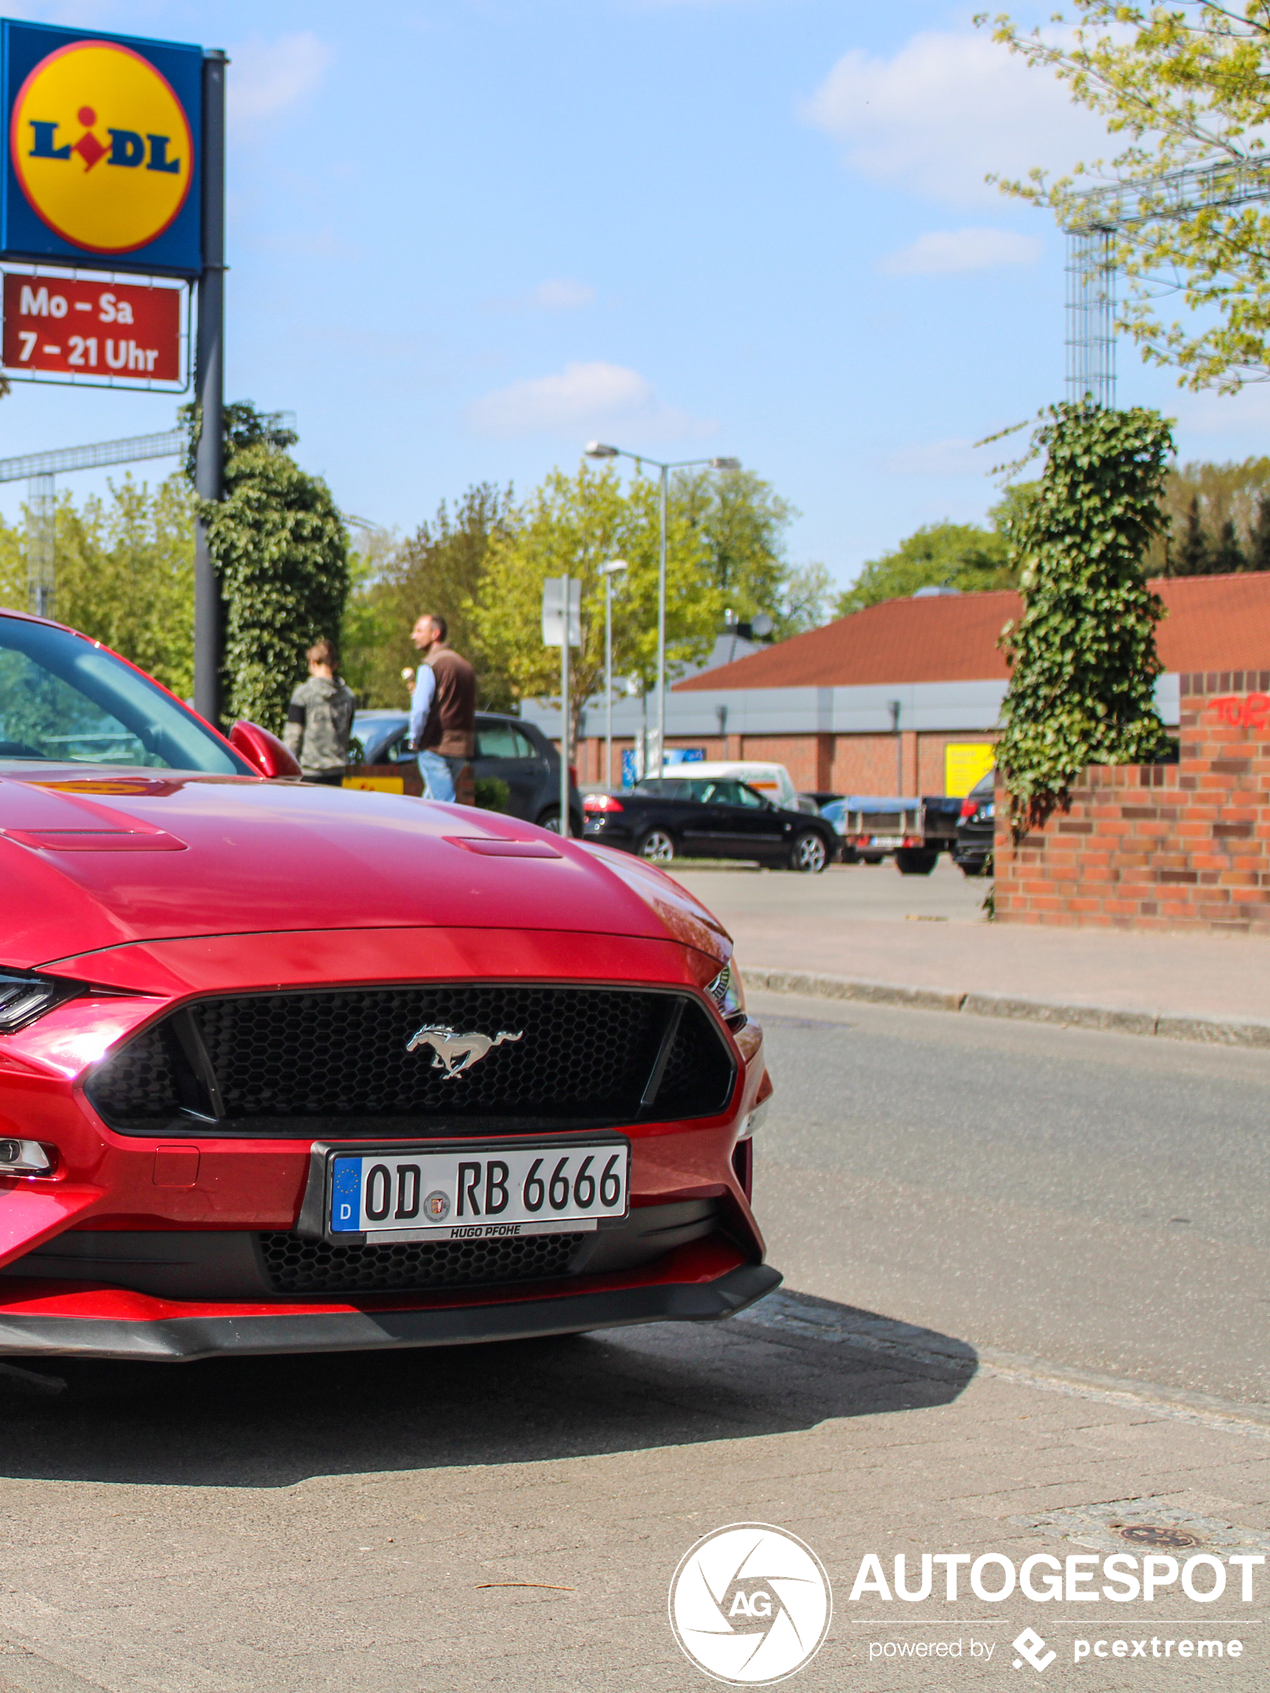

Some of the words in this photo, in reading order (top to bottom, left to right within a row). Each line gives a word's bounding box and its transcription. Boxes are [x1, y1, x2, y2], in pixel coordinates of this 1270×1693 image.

[19, 285, 68, 319] Mo
[98, 292, 134, 325] Sa
[18, 331, 38, 361] 7
[67, 336, 98, 367] 21
[104, 338, 159, 371] Uhr
[364, 1163, 422, 1222] OD
[456, 1160, 510, 1217] RB
[522, 1154, 621, 1213] 6666
[340, 1204, 352, 1220] D
[450, 1227, 483, 1239] HUGO
[485, 1225, 521, 1237] PFOHE
